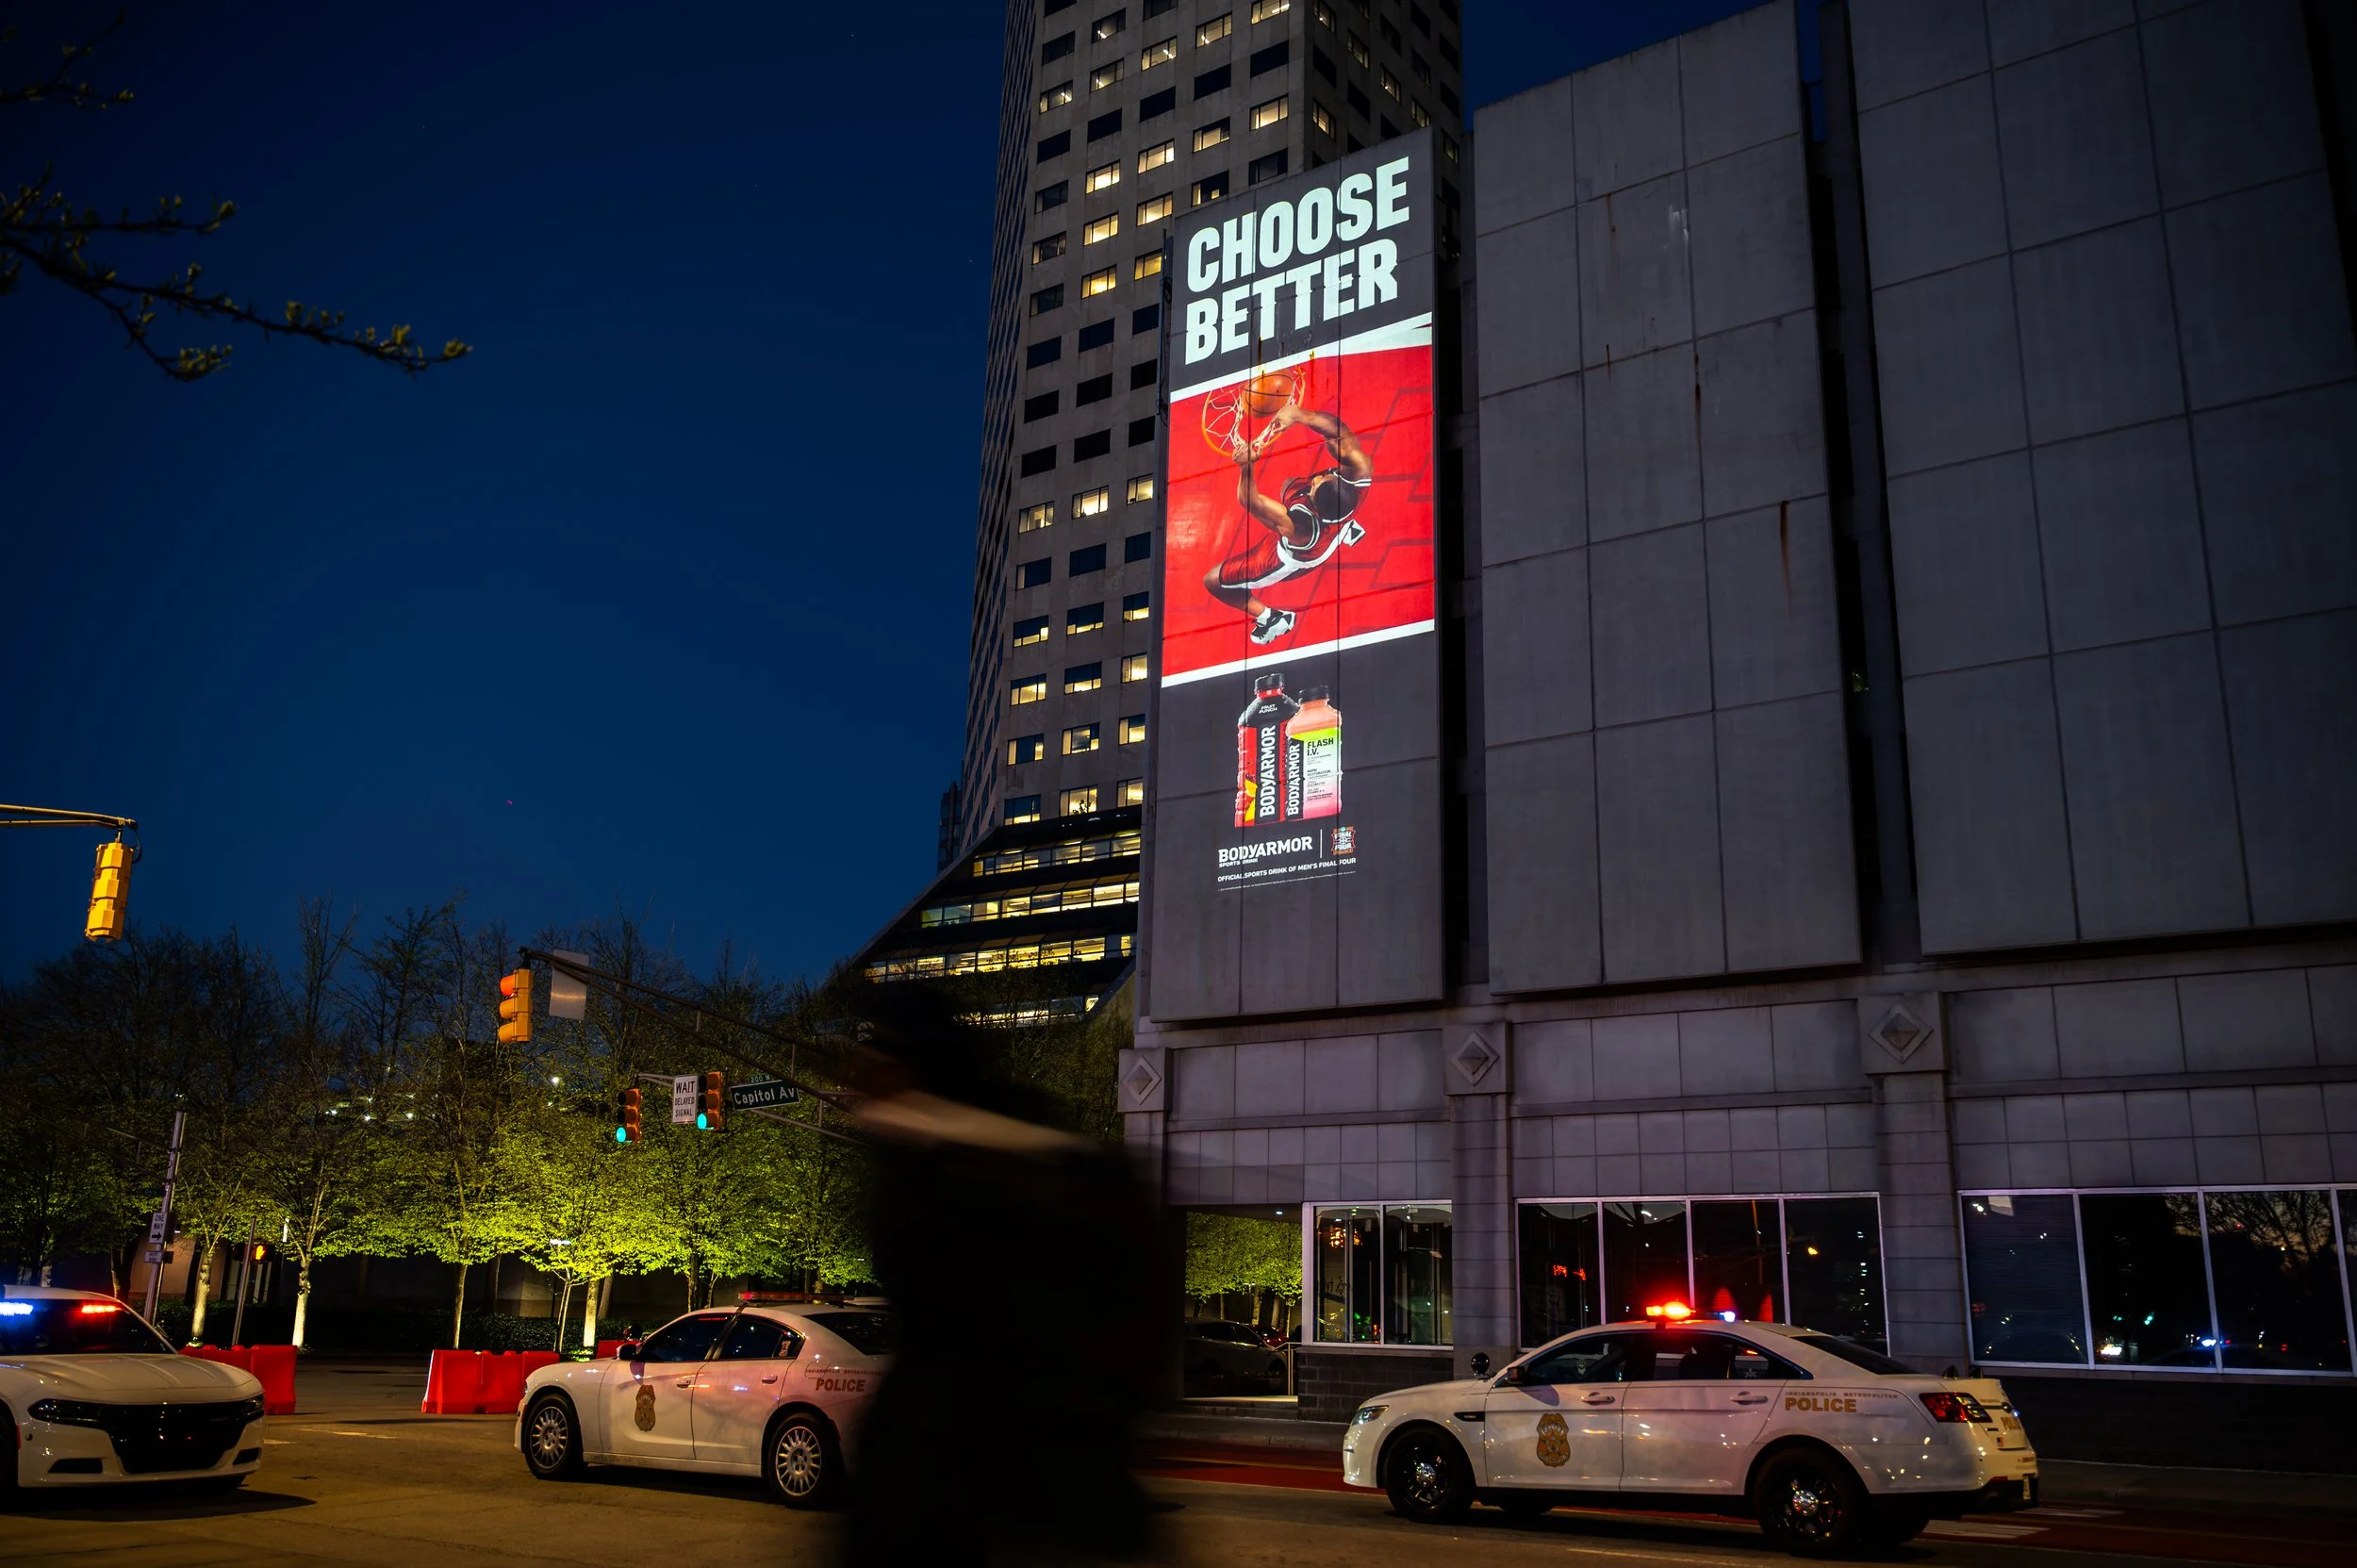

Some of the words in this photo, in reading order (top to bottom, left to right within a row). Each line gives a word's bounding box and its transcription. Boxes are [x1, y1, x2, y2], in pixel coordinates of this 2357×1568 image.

[1187, 156, 1409, 292] CHOOSE
[1185, 239, 1397, 365] BETTER
[1307, 737, 1334, 749] FLASH
[1307, 748, 1319, 756] I.V.
[1260, 724, 1276, 817] BODYARMOR
[1287, 743, 1301, 816] BODYARMOR
[1218, 836, 1313, 863] BODYARMOR
[1217, 873, 1244, 882] OFFICIAL
[1244, 869, 1268, 879] SPORTS
[1268, 867, 1288, 875] DRINK
[1339, 857, 1357, 866] FOUR
[750, 1075, 764, 1083] 200
[675, 1081, 696, 1094] WAIT
[674, 1097, 695, 1106] DELAYED
[734, 1087, 775, 1105] Capitol
[780, 1086, 795, 1099] Av
[675, 1109, 693, 1117] SIGNAL
[155, 1213, 165, 1222] ONE
[153, 1222, 164, 1230] WAY
[816, 1378, 865, 1392] POLICE
[1785, 1397, 1856, 1412] POLICE
